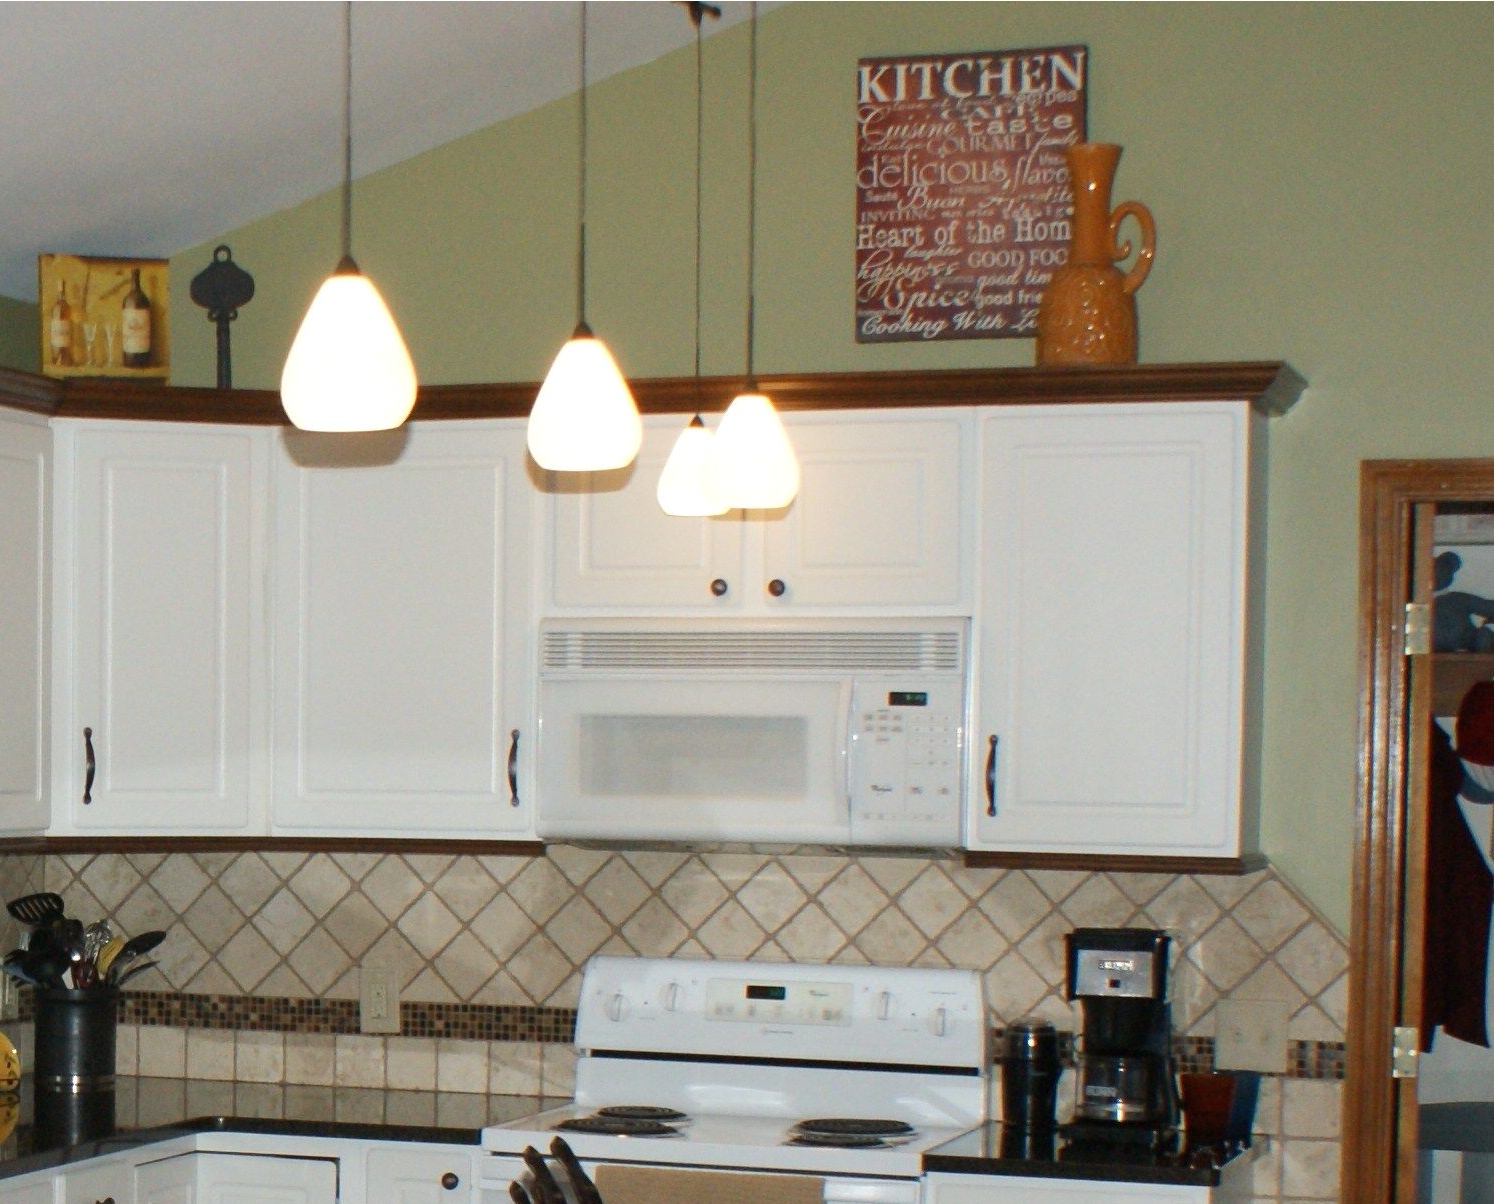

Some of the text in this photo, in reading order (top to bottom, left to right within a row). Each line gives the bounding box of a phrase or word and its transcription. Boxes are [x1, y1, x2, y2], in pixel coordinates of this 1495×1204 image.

[858, 52, 1085, 104] KITCHEN
[857, 105, 956, 146] Cuisine
[966, 113, 1074, 137] taste
[1012, 150, 1072, 191] flavo
[857, 216, 1073, 249] Heart of the Hom
[967, 247, 1069, 268] GOOD FOO
[976, 265, 1023, 294] good
[1024, 268, 1053, 286] tim
[882, 278, 971, 320] Spice
[974, 289, 1014, 310] good
[861, 312, 949, 339] Cooking
[952, 309, 1008, 332] With
